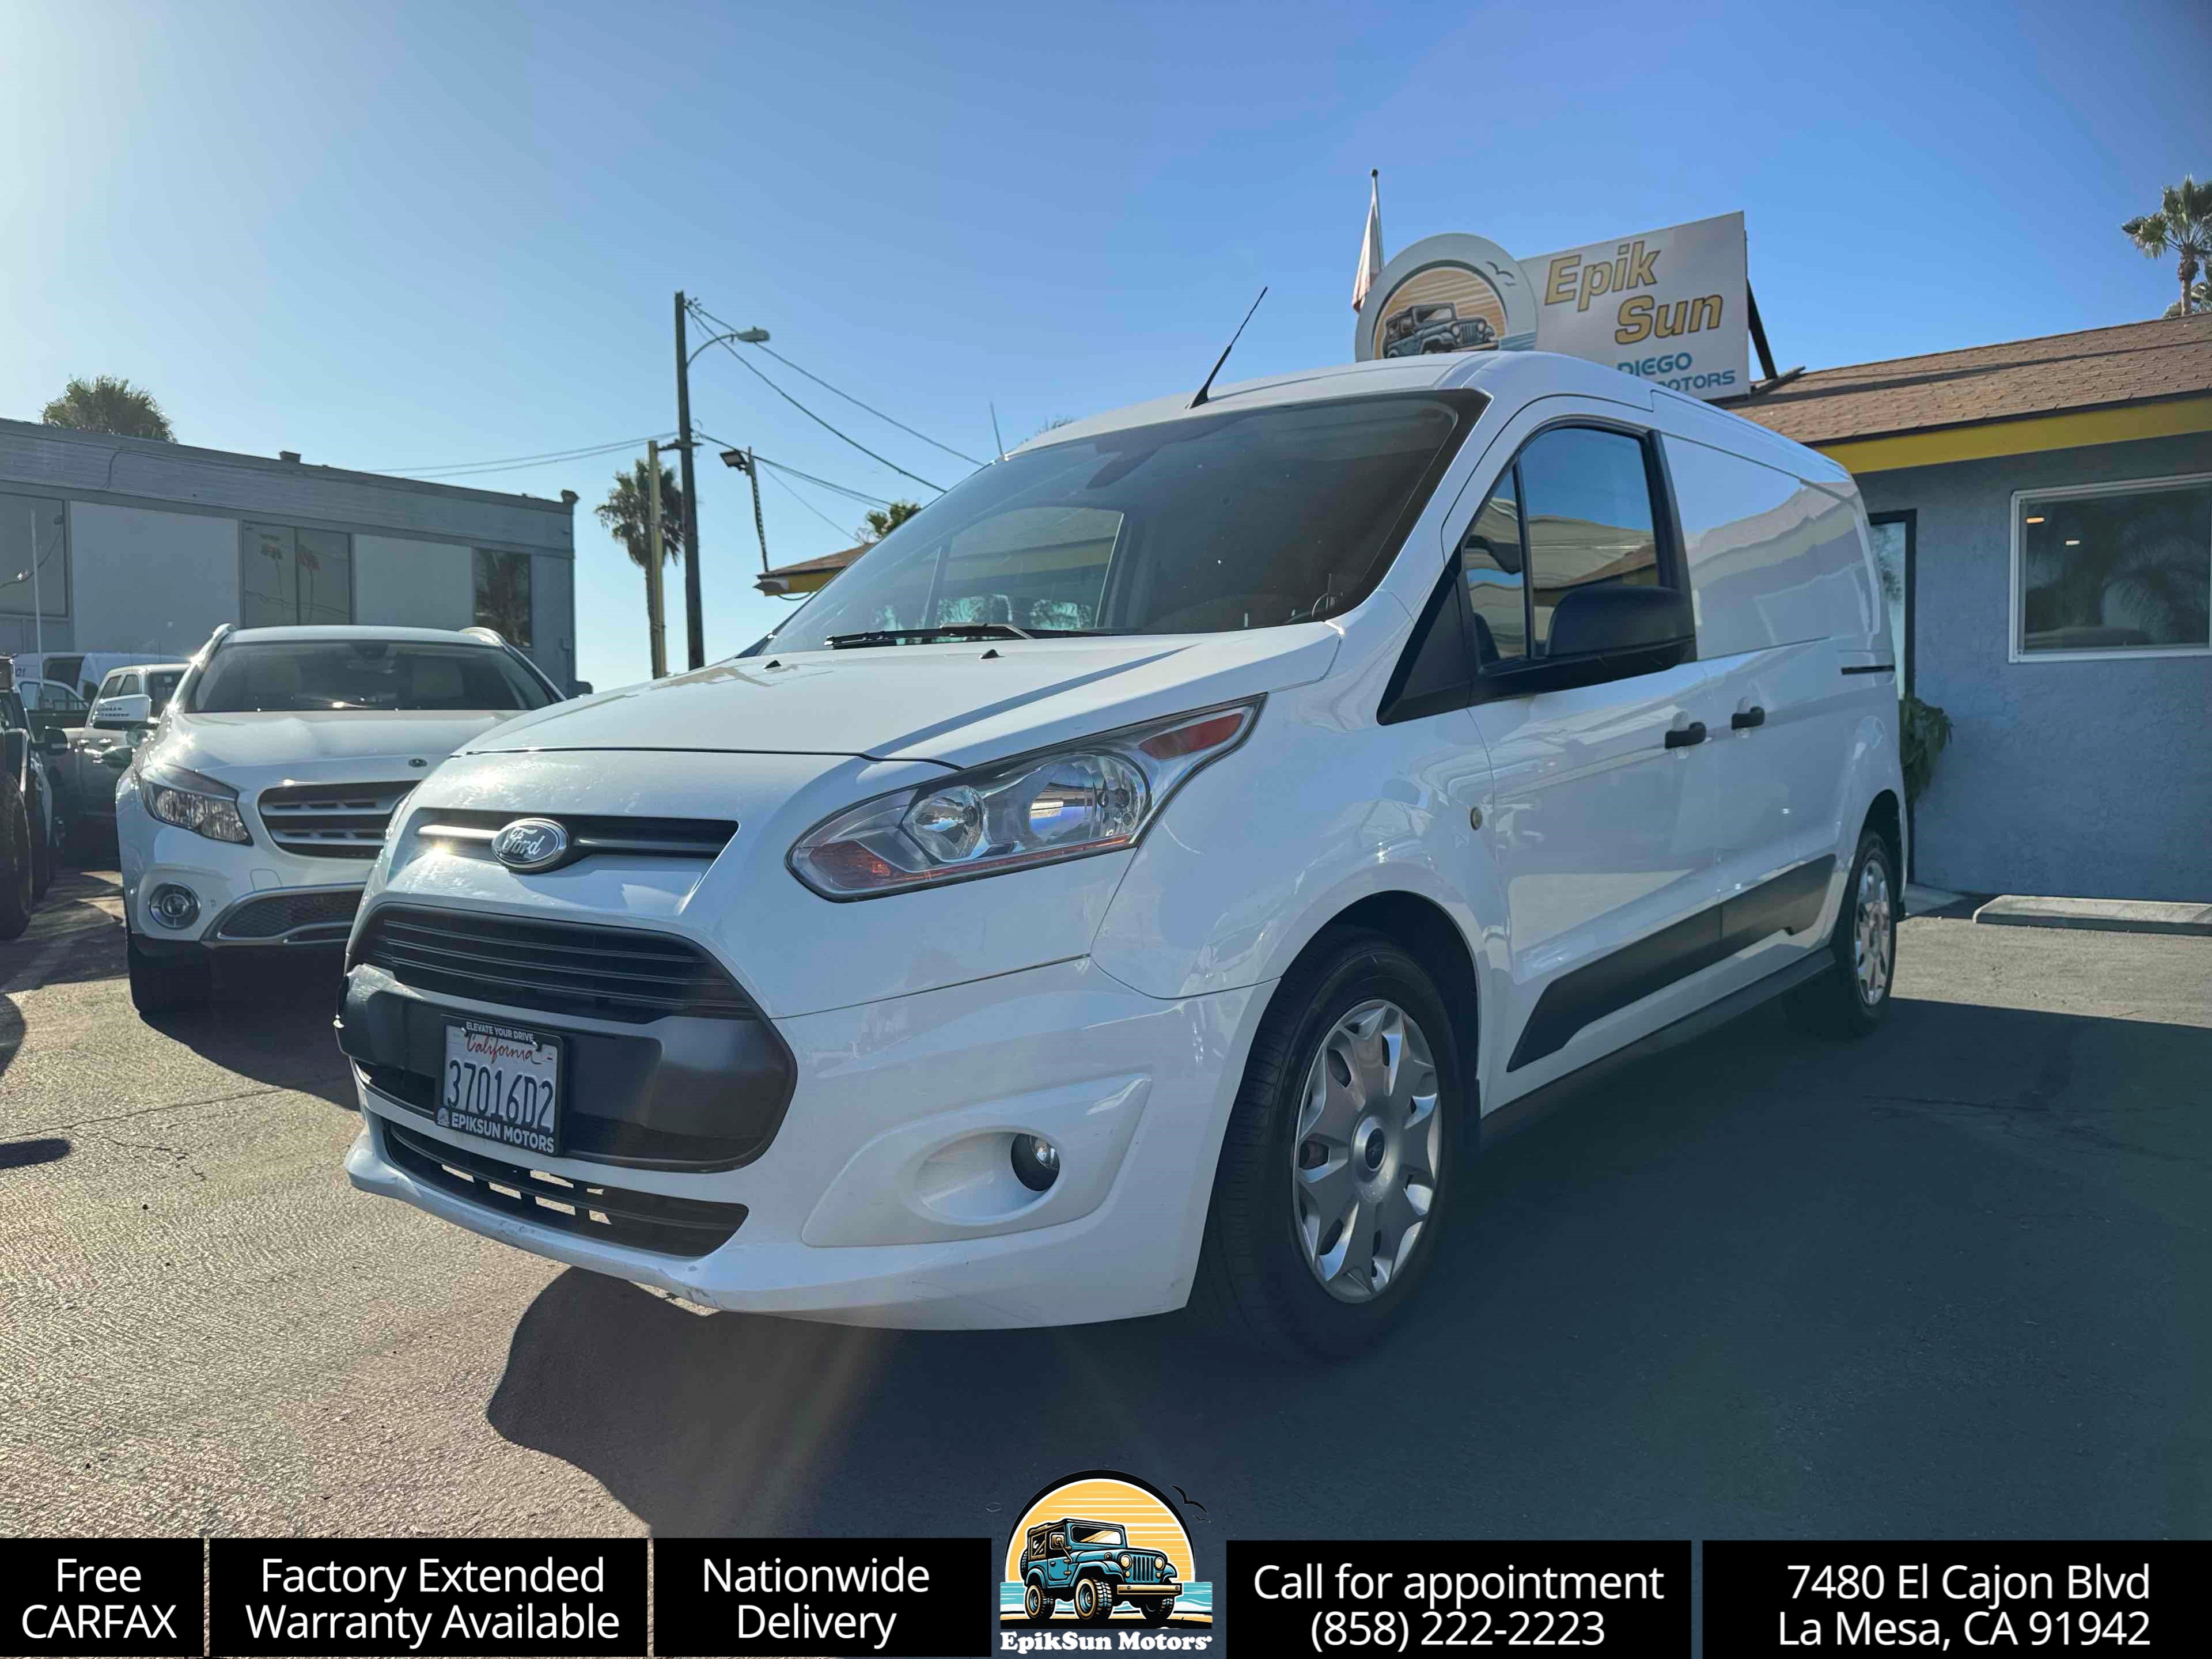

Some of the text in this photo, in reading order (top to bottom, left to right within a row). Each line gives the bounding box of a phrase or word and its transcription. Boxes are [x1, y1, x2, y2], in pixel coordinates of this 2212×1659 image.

[1544, 240, 1661, 312] Epik
[1615, 294, 1723, 344] Sun
[1618, 352, 1692, 377] DIEGO
[499, 827, 546, 856] Ford
[465, 1021, 535, 1043] ELEVATE YOUR DRIVE
[466, 1033, 542, 1065] California
[447, 1059, 554, 1134] 37016D2
[451, 1112, 555, 1153] EPIKSUN MOTORS
